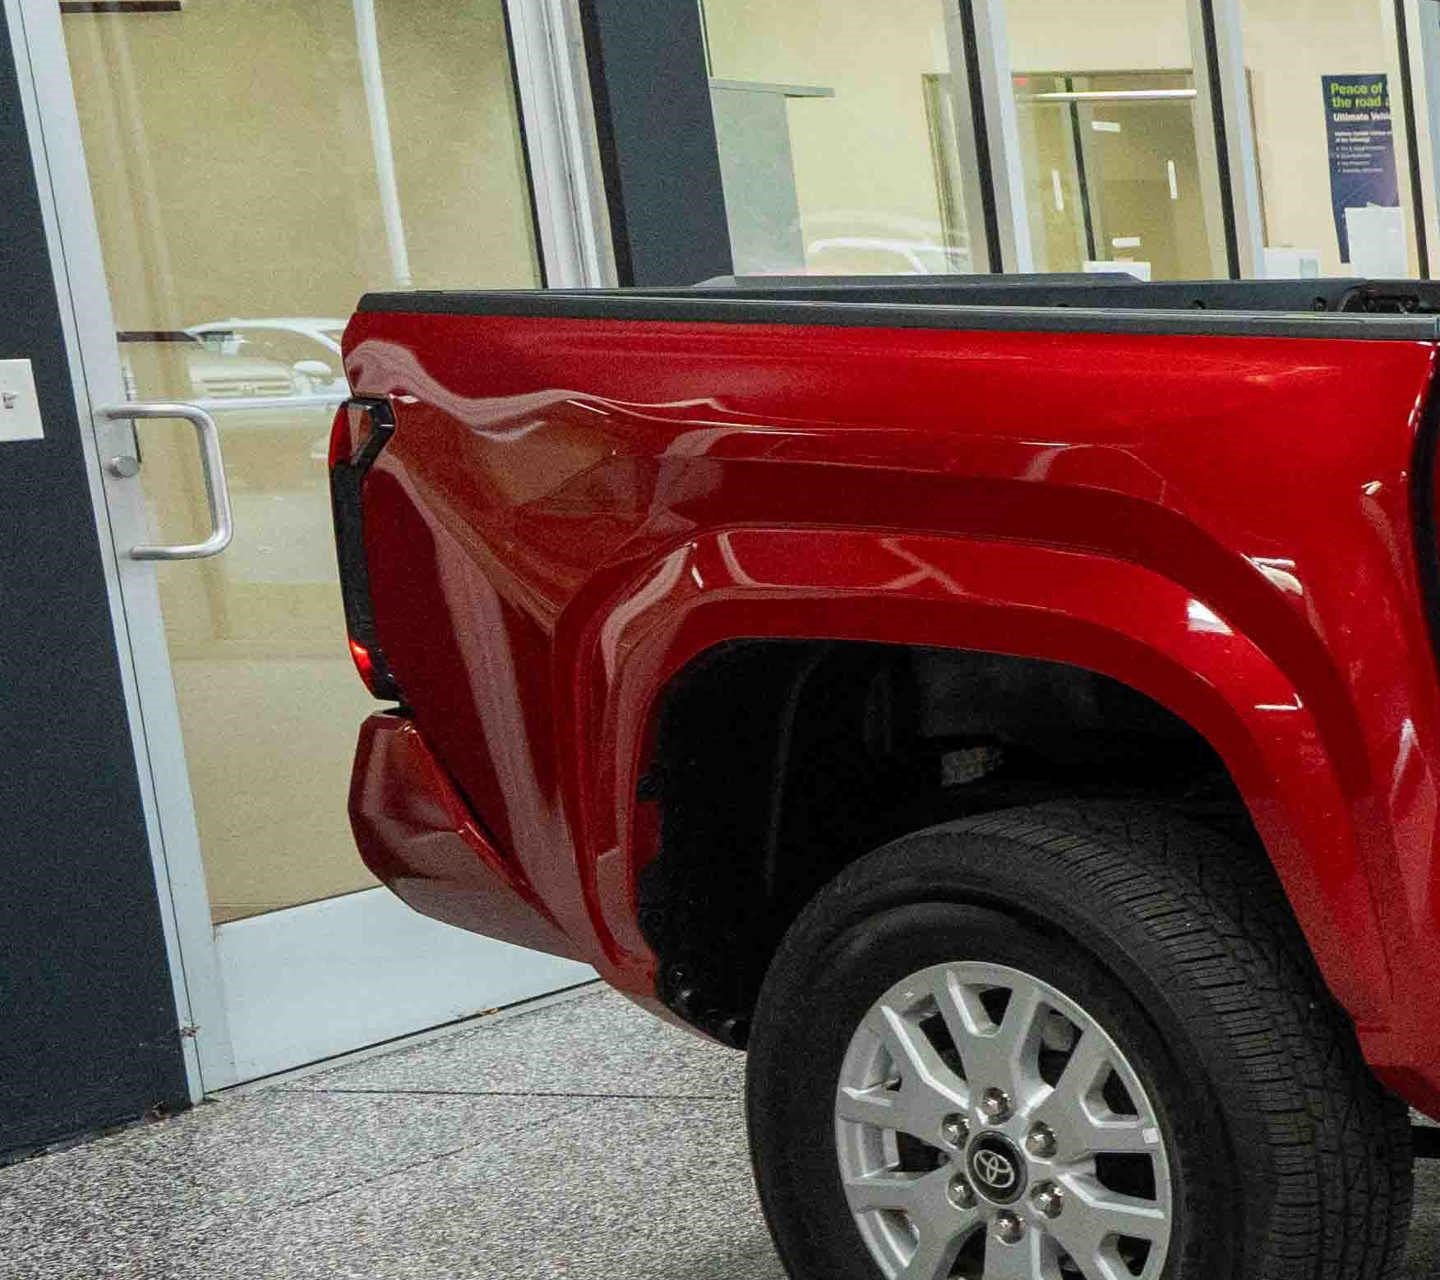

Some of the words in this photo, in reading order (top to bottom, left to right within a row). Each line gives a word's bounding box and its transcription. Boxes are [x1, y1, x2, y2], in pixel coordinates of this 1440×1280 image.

[1330, 82, 1368, 95] Peace
[1370, 81, 1383, 94] of
[1332, 95, 1352, 108] the
[1355, 95, 1382, 108] road
